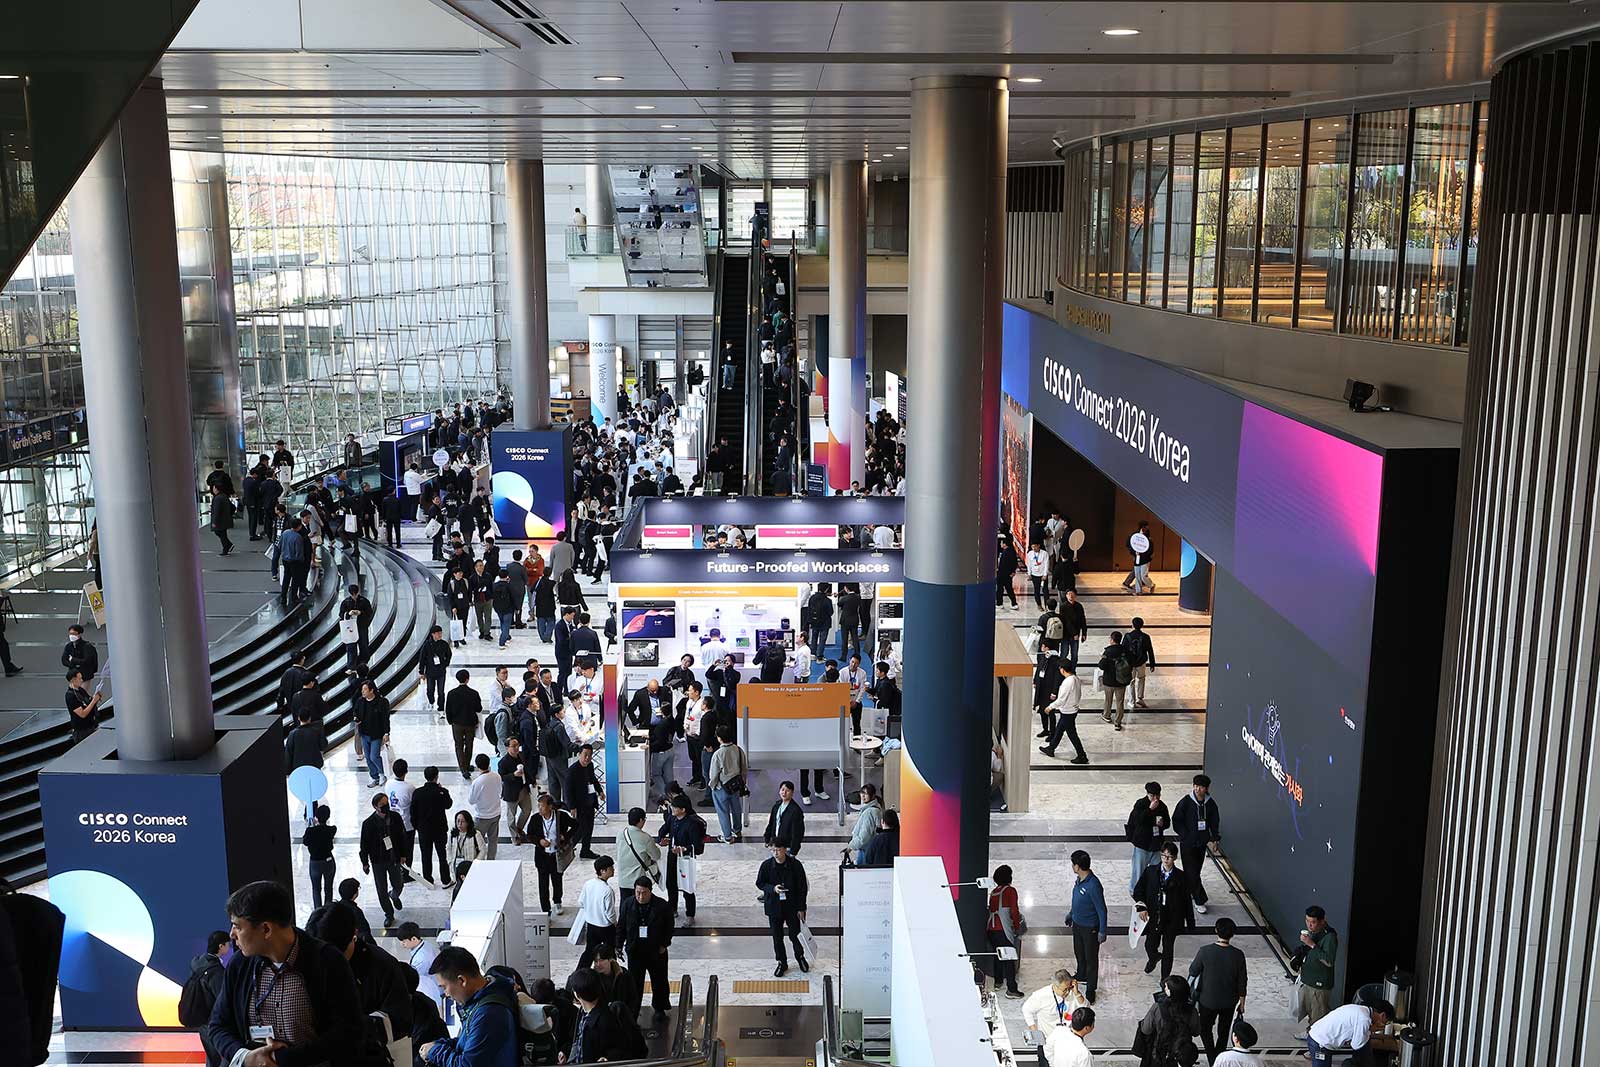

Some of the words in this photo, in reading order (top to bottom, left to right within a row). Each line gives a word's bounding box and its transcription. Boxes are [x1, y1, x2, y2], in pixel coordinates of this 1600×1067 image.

[598, 363, 607, 404] Welcome
[1075, 373, 1113, 433] Connect
[1116, 397, 1146, 453] 2026
[1149, 414, 1190, 483] Korea
[707, 561, 808, 573] Future-Proofed
[811, 561, 890, 575] Workplaces
[79, 813, 128, 825] CISCO
[133, 813, 188, 826] Connect
[93, 829, 131, 843] 2026
[135, 829, 176, 843] Korea
[533, 925, 546, 936] 1F
